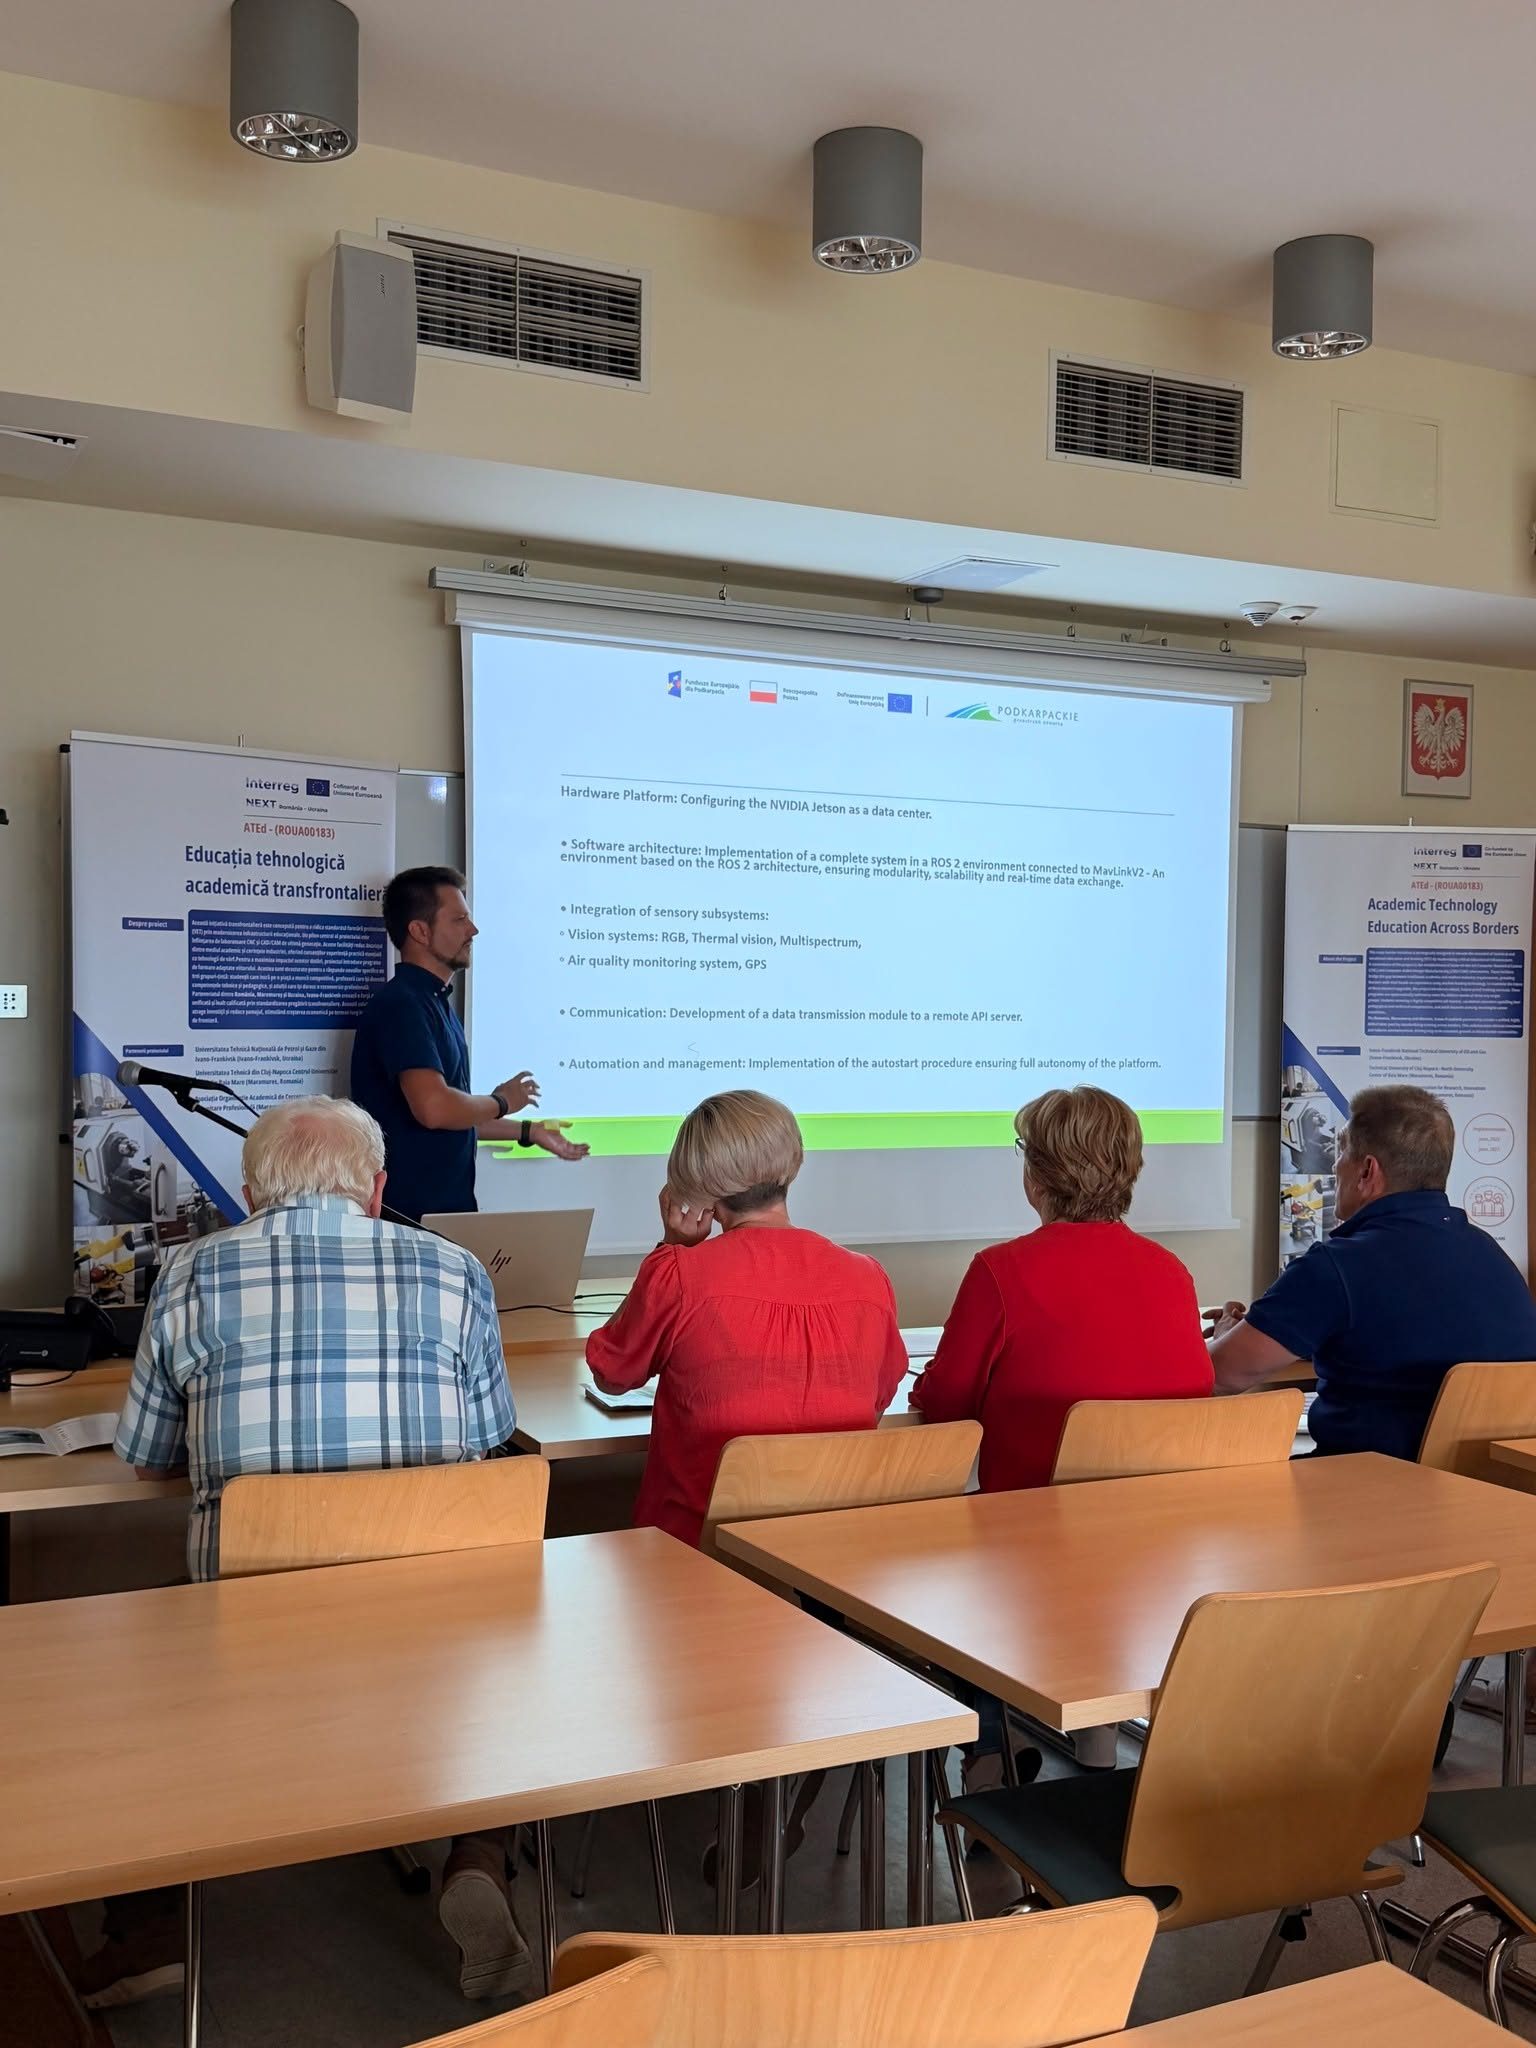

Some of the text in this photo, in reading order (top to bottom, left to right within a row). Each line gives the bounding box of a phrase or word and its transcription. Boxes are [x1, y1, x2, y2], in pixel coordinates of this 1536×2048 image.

[998, 706, 1079, 722] PODKARPACKIE
[246, 798, 277, 808] NEXT
[561, 785, 932, 820] Hardware Platform: Configuring the NVIDIA Jetson as a data center.
[244, 822, 266, 834] ATEd
[275, 824, 335, 840] (ROUA00183)
[185, 845, 345, 873] Educația tehnologică
[571, 838, 625, 852] Software
[628, 842, 702, 856] architecture:
[705, 845, 793, 861] Implementation
[796, 850, 808, 861] of
[810, 853, 817, 862] a
[820, 852, 869, 865] complete
[871, 855, 907, 867] system
[909, 856, 919, 867] in
[922, 859, 928, 867] a
[931, 857, 951, 868] ROS
[954, 858, 960, 869] 2
[963, 860, 1026, 872] environment
[1028, 862, 1078, 875] connected
[1080, 865, 1090, 875] to
[1152, 869, 1165, 878] An
[560, 851, 1124, 889] environment based on the ROS 2 architecture, ensuring modularity, scalability and real-time data exchange.
[185, 877, 269, 896] academică
[1411, 882, 1429, 890] ATEd
[1435, 882, 1483, 891] (ROUA00183)
[570, 903, 769, 922] Integration of sensory subsystems:
[1368, 898, 1498, 915] Academic Technology
[128, 920, 147, 928] Despre
[1368, 921, 1519, 935] Education Across Borders
[568, 928, 862, 950] Vision systems: RGB, Thermal vision, Multispectrum,
[568, 955, 767, 971] Air quality monitoring system, GPS
[569, 1007, 1023, 1022] Communication: Development of a data transmission module to a remote API server.
[569, 1057, 1161, 1071] Automation and management: Implementation of the autostart procedure ensuring full autonomy of the platform.
[489, 1249, 512, 1273] hp
